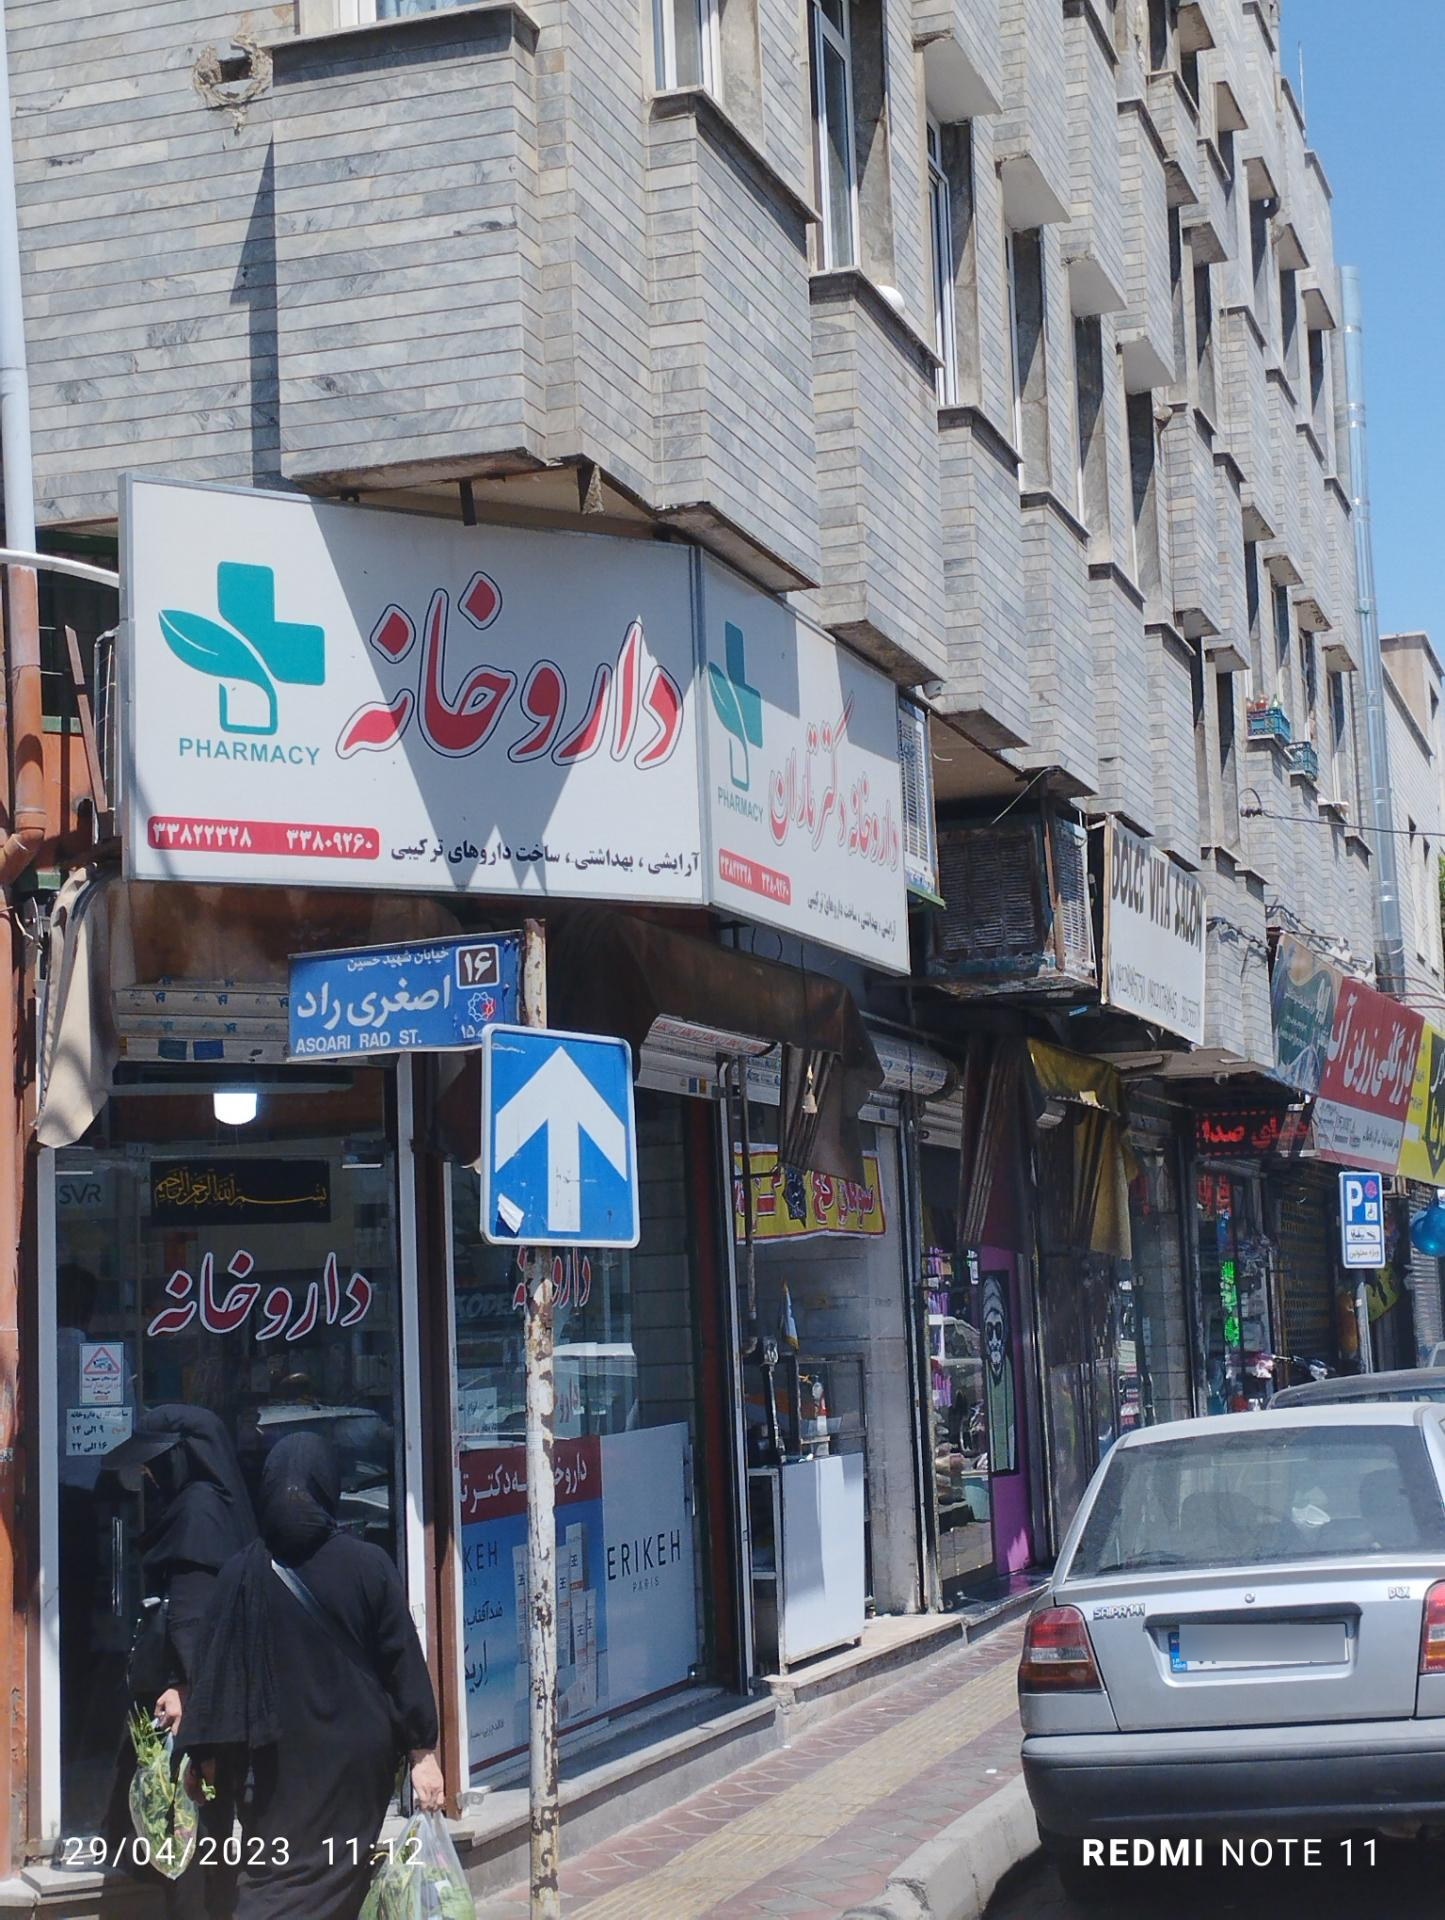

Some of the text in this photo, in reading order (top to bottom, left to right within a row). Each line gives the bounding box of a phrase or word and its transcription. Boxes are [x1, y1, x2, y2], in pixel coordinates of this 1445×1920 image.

[336, 571, 683, 770] داروخانه
[179, 737, 320, 766] PHARMACY
[812, 690, 854, 851] دکتر
[717, 786, 764, 824] PHARMACY
[153, 822, 252, 848] ۳۳۸۲۲۳۲۸
[849, 771, 899, 872] داروخانه
[286, 829, 373, 855] ۳۳۸۰۹۲۶۰
[391, 838, 443, 864] ترکیبی
[448, 840, 512, 865] داروهای
[516, 843, 560, 864] ساخت
[1111, 828, 1145, 914] DOLCE
[1149, 852, 1171, 930] VITA
[347, 947, 449, 972] خیابان شهید حسین
[464, 951, 494, 983] ۱۶
[296, 974, 451, 1031] اصغری راد
[296, 1029, 423, 1054] ASQARI RAD ST.
[148, 1249, 373, 1341] داروخانه
[607, 1529, 681, 1581] ERIKEH
[632, 1576, 660, 1592] PARIS
